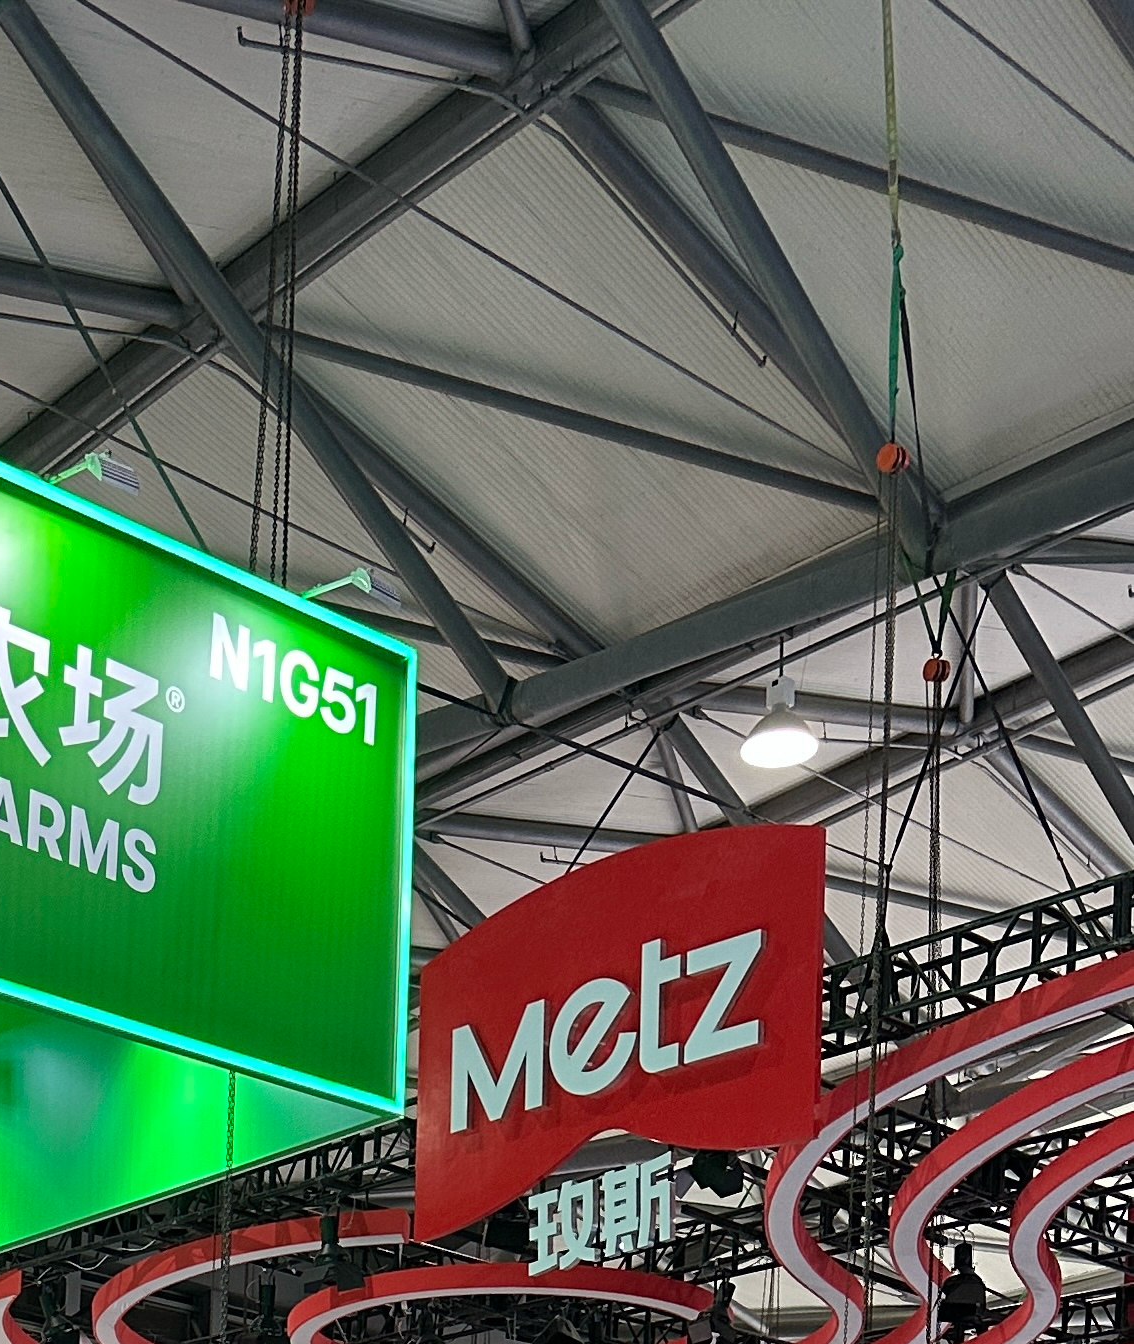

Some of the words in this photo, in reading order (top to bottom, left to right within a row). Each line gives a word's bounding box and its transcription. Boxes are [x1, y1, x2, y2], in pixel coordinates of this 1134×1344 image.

[208, 612, 378, 746] N1G51
[449, 928, 764, 1134] Metz
[528, 1151, 677, 1278] 玫斯
